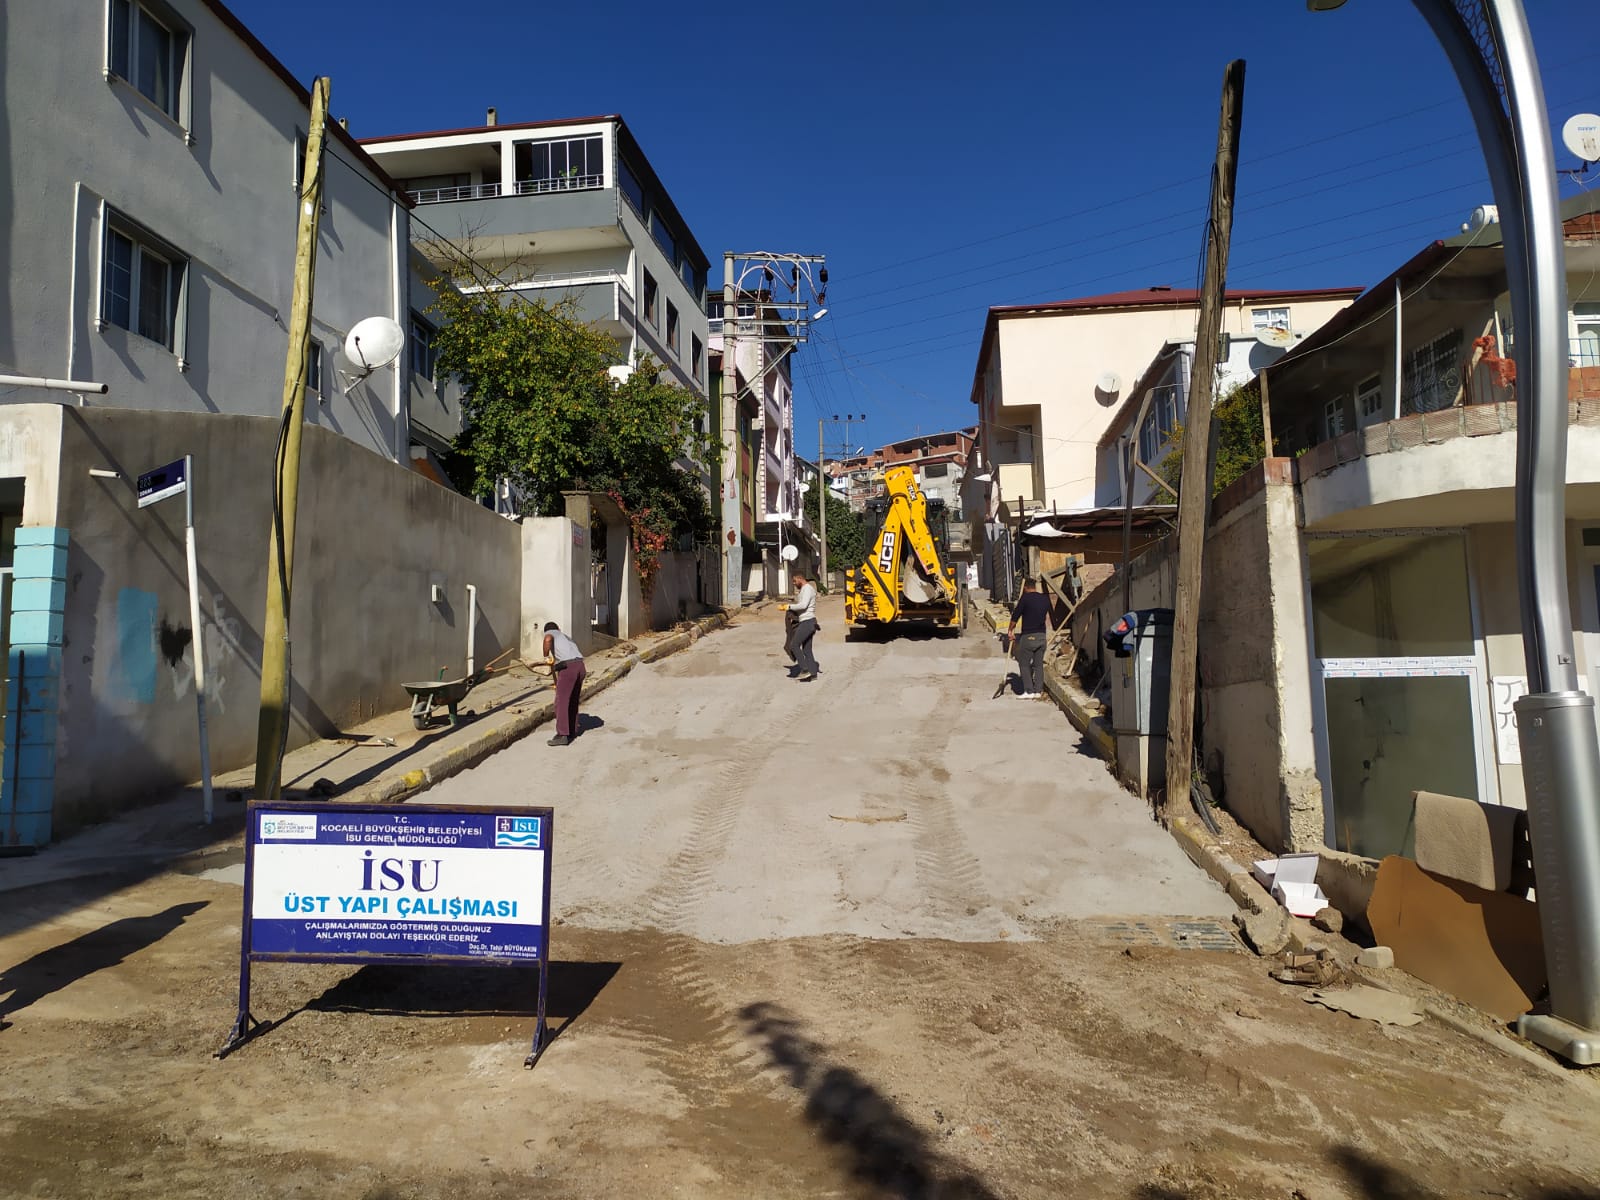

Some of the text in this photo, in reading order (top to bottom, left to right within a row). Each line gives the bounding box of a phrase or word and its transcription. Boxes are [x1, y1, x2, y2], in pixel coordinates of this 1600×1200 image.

[881, 532, 895, 573] JCB
[394, 816, 410, 824] T.C.
[321, 824, 482, 835] KOCAELİ BÜYÜKŞEHİR BELEDİYESİ
[346, 833, 457, 844] İSU GENEL MÜDÜRLÜĞÜ
[358, 849, 443, 892] İSU
[284, 892, 517, 919] ÜST YAPI ÇALIŞMASI
[305, 922, 492, 933] ÇALIŞMALARIMIZDA GÖSTERMİŞ OLDUĞUNUZ
[315, 932, 368, 940] ANLAYIŞTAN
[369, 932, 400, 940] DOLAYI
[402, 932, 447, 942] TEŞEKKÜR
